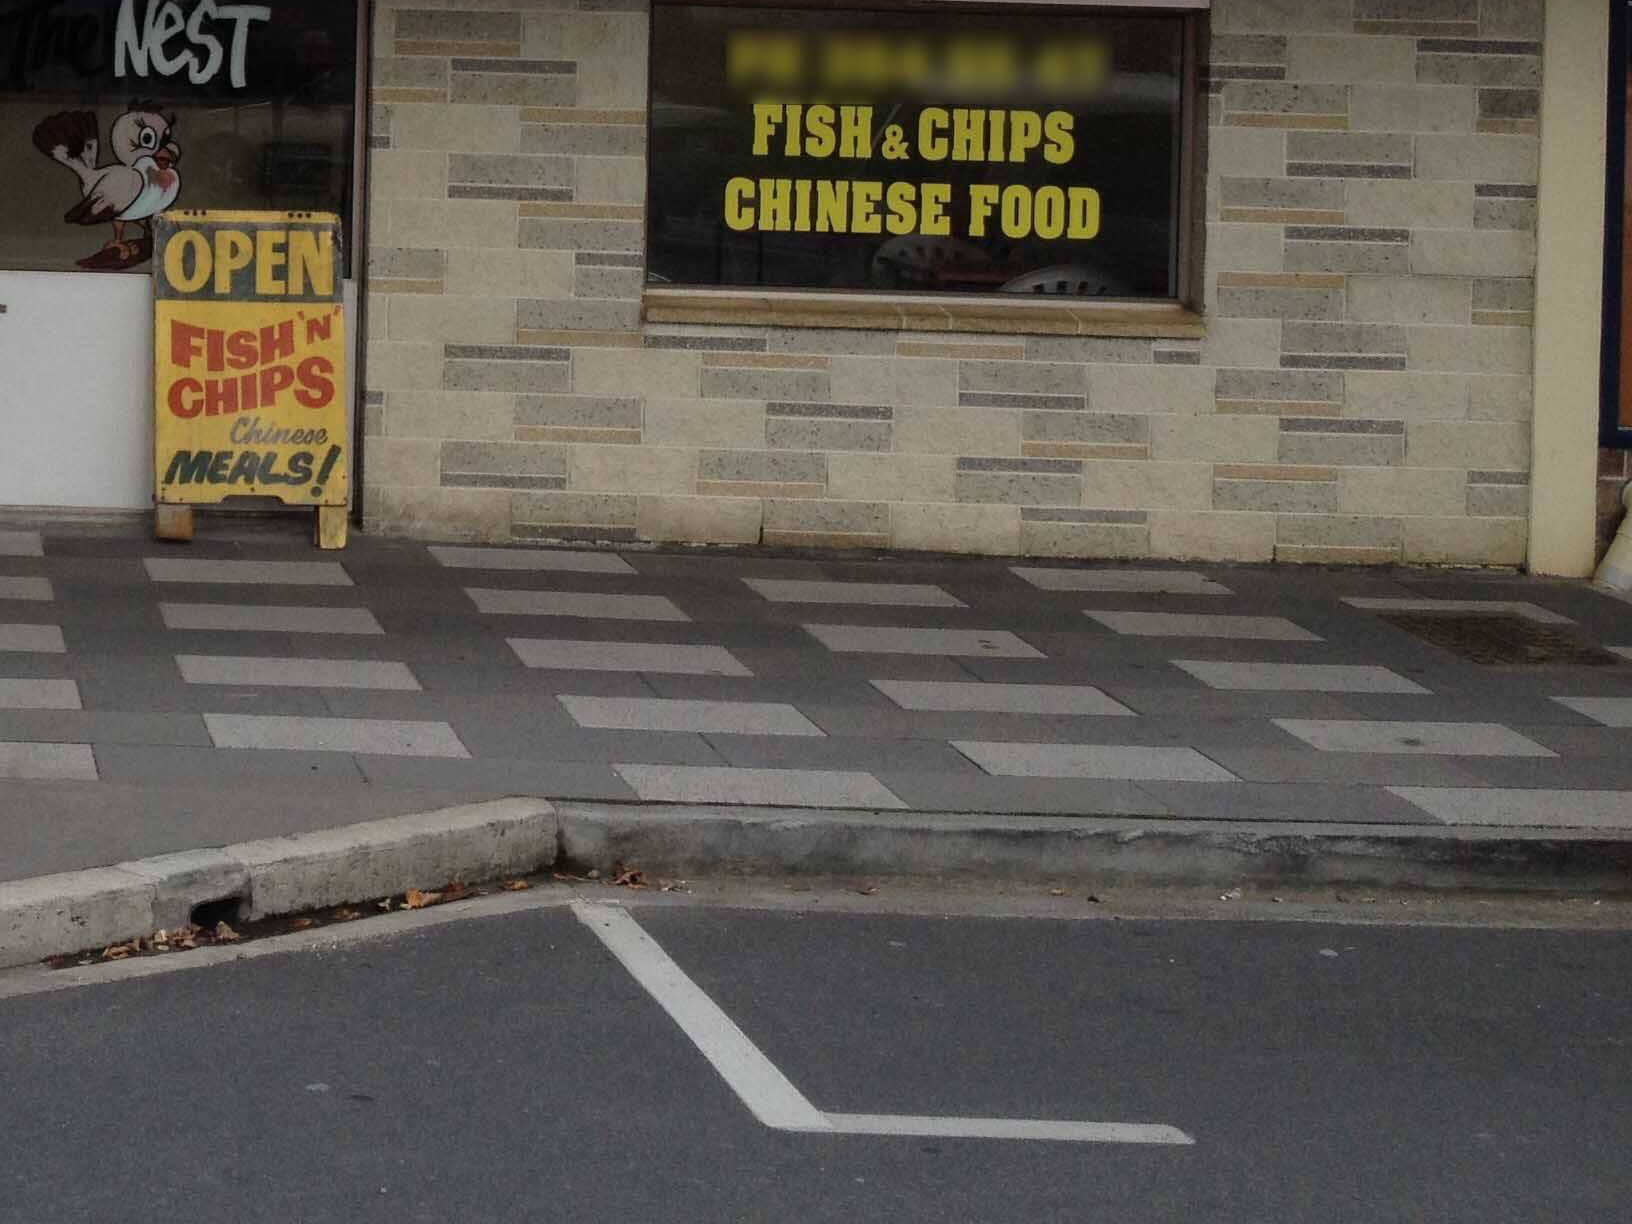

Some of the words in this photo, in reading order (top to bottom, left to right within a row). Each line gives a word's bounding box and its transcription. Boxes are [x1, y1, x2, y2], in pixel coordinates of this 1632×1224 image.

[752, 103, 873, 159] FISH
[881, 123, 910, 160] &
[918, 107, 1075, 164] CHIPS
[724, 177, 951, 236] CHINESE
[969, 184, 1100, 239] FOOD
[164, 229, 335, 296] OPEN
[170, 319, 295, 372] FISH
[168, 356, 336, 420] CHIPS
[230, 415, 329, 445] Chinese
[164, 443, 342, 498] MEALS!
